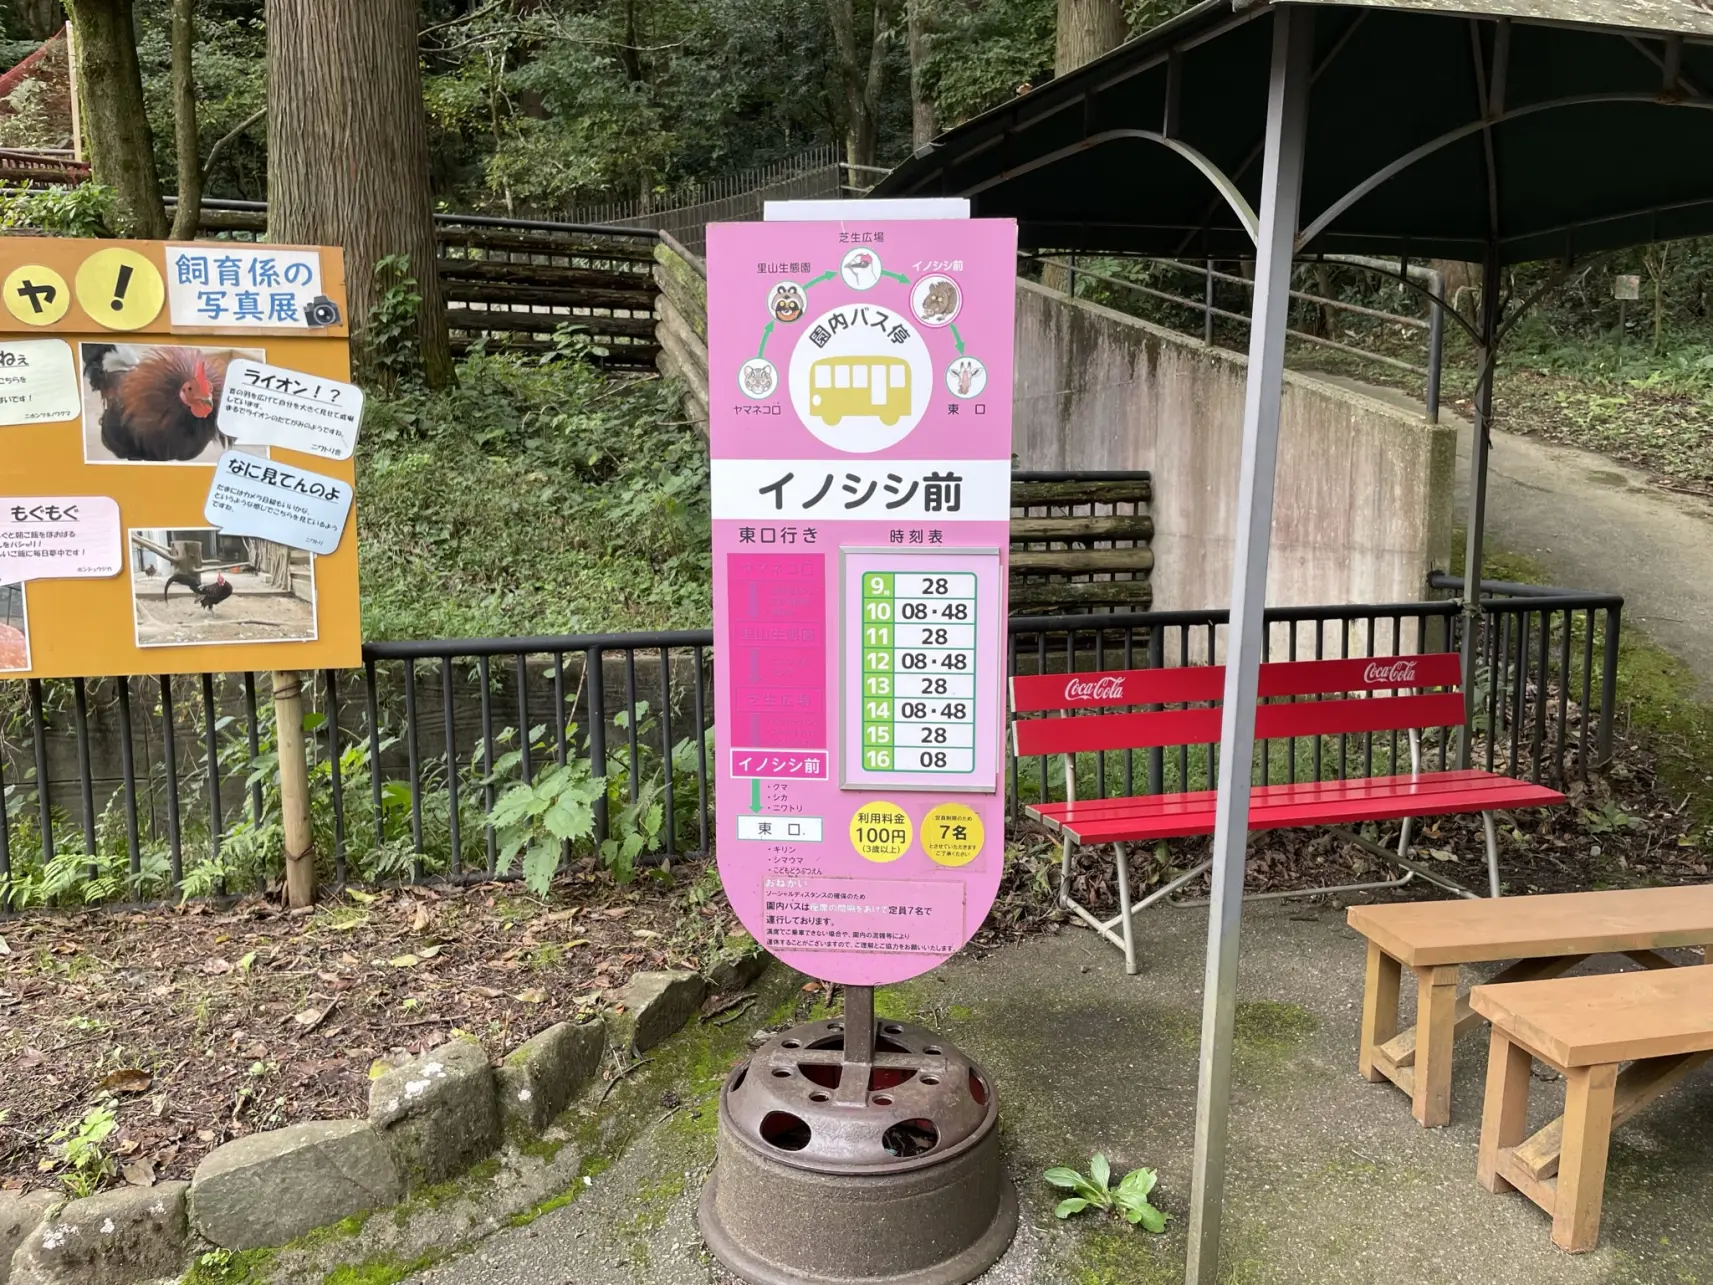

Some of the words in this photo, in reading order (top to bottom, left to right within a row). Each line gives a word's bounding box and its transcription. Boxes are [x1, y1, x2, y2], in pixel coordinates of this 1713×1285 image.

[839, 232, 884, 244] 芝生広場
[176, 254, 313, 287] 飼育係の
[757, 262, 811, 274] 里山生態園
[912, 260, 963, 272] イノシシ前
[197, 290, 300, 322] 写真展
[808, 307, 912, 349] 園内バス停
[228, 458, 340, 501] なに見てんのよ
[759, 472, 963, 512] イノシシ前
[11, 505, 79, 521] もぐもぐ
[739, 526, 818, 544] 東口行き
[890, 529, 944, 544] 時刻表
[922, 578, 948, 595] 28
[866, 603, 891, 620] 10
[866, 628, 888, 645] 11
[922, 628, 948, 645] 28
[867, 653, 889, 670] 12
[1364, 660, 1417, 683] Coca-Cola
[867, 677, 890, 694] 13
[921, 678, 947, 695] 28
[1065, 676, 1125, 701] Coca-Cola
[867, 702, 890, 719] 14
[867, 726, 889, 743] 15
[921, 727, 947, 744] 28
[738, 757, 820, 774] イノシシ前
[867, 751, 889, 767] 16
[920, 751, 947, 768] 08
[858, 812, 905, 825] 利用料金
[857, 828, 906, 844] 100円
[940, 825, 967, 840] 7名
[766, 890, 866, 900] ソーシャルディスタンスの確保のため
[766, 915, 834, 926] 運行しております。
